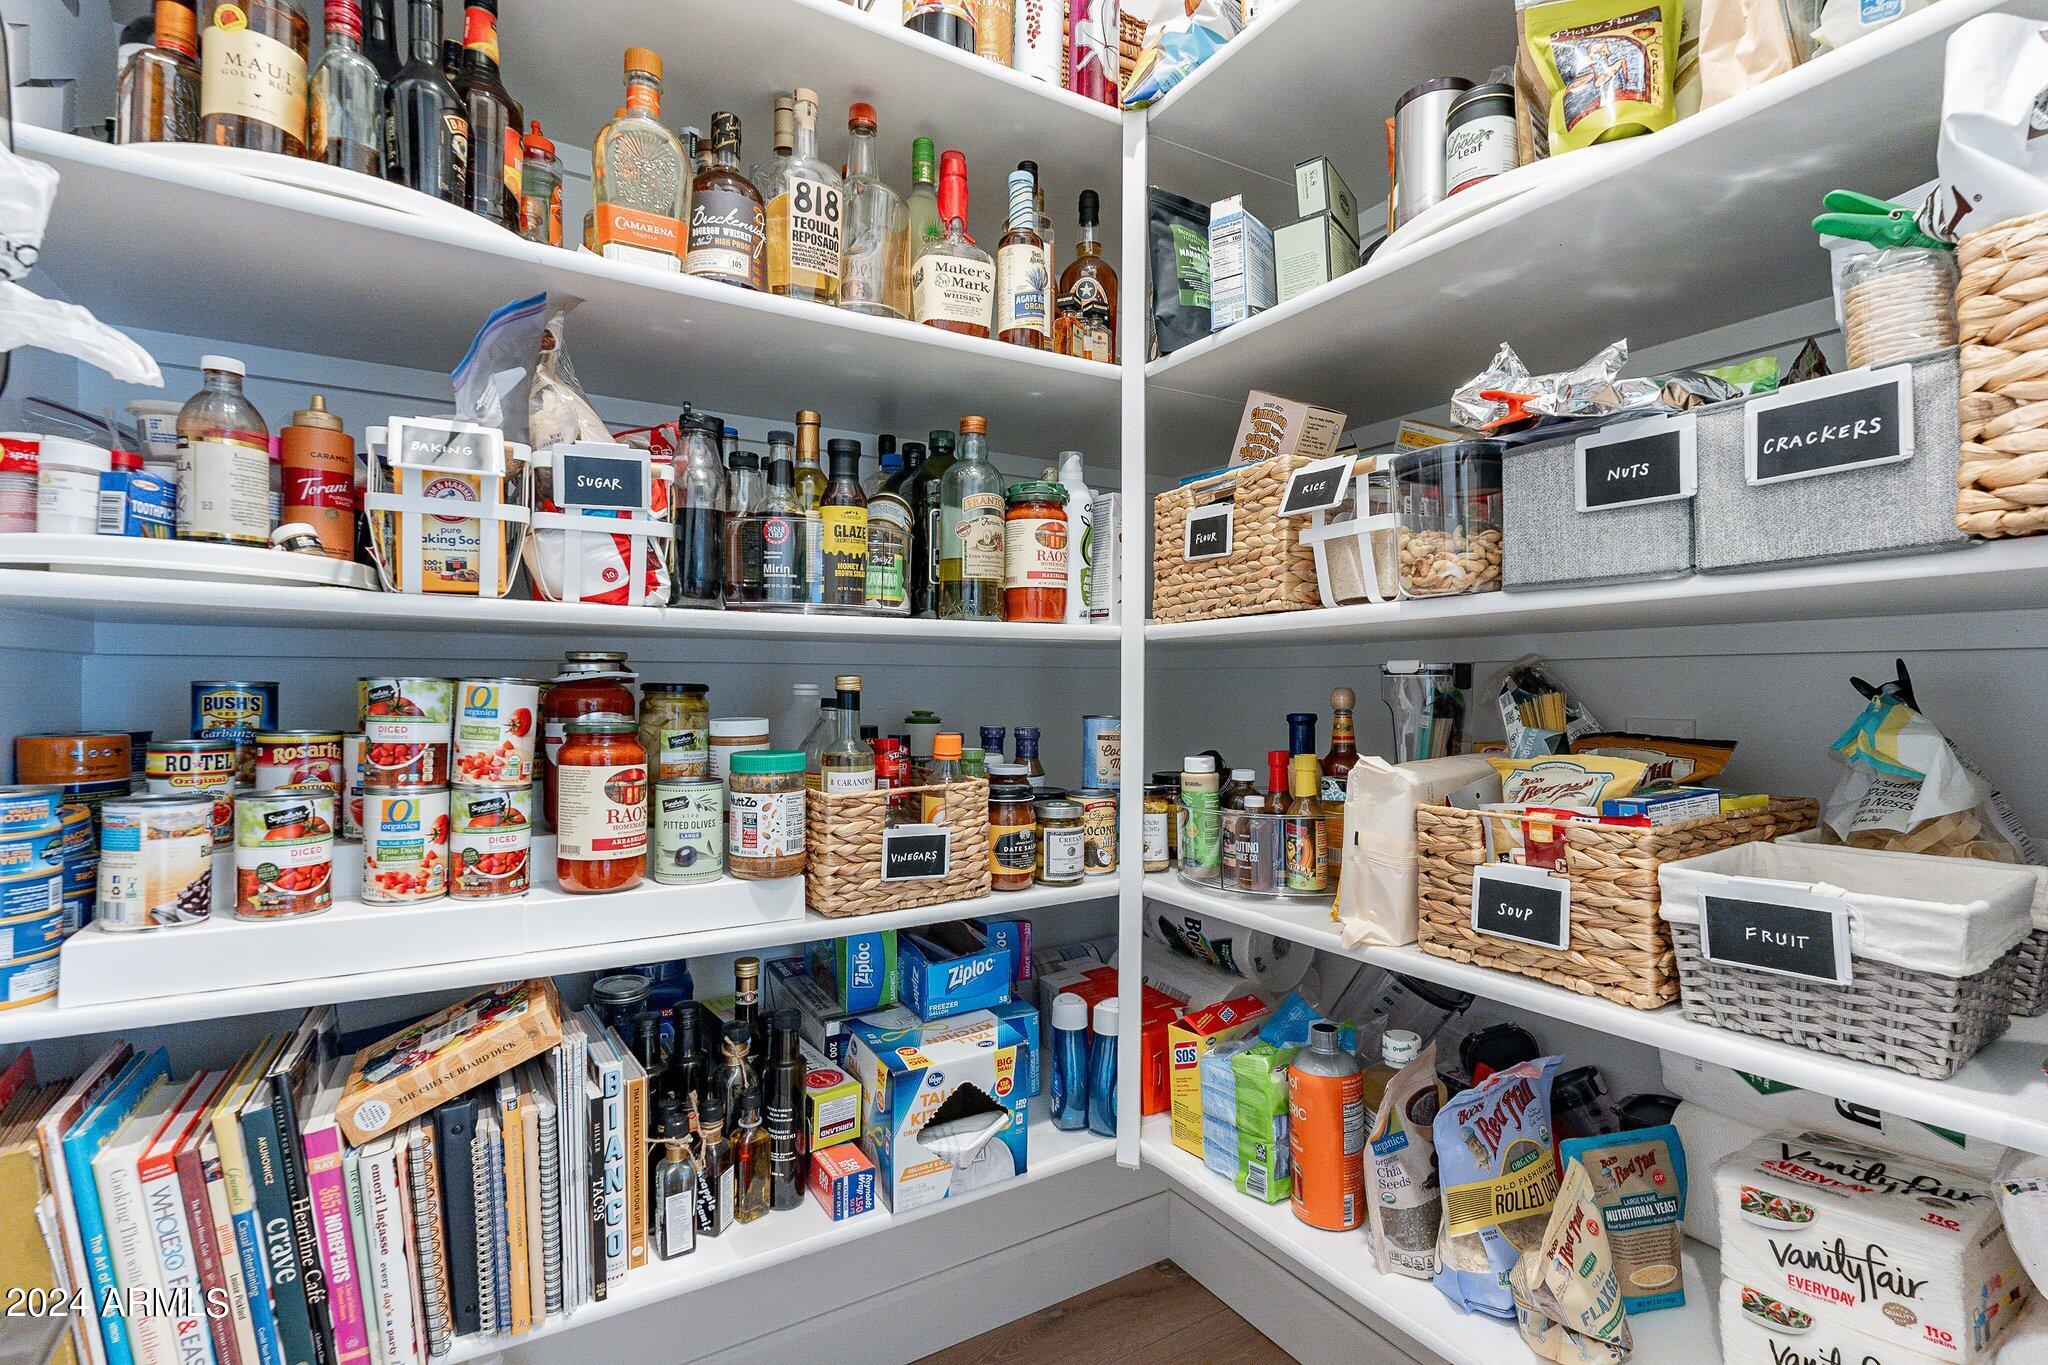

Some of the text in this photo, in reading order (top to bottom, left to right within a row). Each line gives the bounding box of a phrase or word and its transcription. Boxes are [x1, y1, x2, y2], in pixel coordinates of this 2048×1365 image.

[221, 68, 257, 80] GOLD
[1458, 141, 1483, 160] Leaf
[794, 181, 840, 222] 818
[614, 215, 675, 239] CAMARENA
[632, 231, 659, 241] TEQUILA
[691, 226, 752, 243] BOURBON WHISKEY
[692, 204, 767, 260] Breckenridge
[792, 215, 840, 240] TEQUILA
[714, 236, 731, 247] HIGH
[792, 229, 840, 254] REPOSADO
[731, 259, 742, 270] 105
[934, 261, 991, 280] Maker's
[951, 275, 991, 293] Mark
[943, 291, 982, 303] WHISKY
[1015, 294, 1038, 304] AGAVE
[1251, 406, 1288, 429] Cinnamon
[1253, 420, 1272, 433] Bun
[1763, 416, 1882, 455] CRACKERS
[310, 451, 350, 464] CARAMEL
[410, 441, 473, 456] BAKING
[1606, 462, 1649, 481] NUTS
[297, 477, 348, 500] Torani
[576, 475, 623, 490] SUGAR
[1302, 481, 1326, 494] RICE
[440, 527, 462, 536] pure
[833, 524, 868, 539] GLAZE
[1195, 531, 1217, 545] FLOUR
[423, 559, 443, 567] 100+
[763, 563, 791, 574] Mirin
[837, 562, 864, 571] HONEY &
[834, 570, 853, 578] BROWN
[203, 696, 262, 712] BUSH'S
[464, 708, 497, 718] organics
[378, 725, 408, 734] DICED
[174, 776, 226, 786] Original
[1871, 798, 1915, 811] Nests
[381, 822, 419, 832] organics
[663, 819, 716, 830] PITTED OLIVES
[488, 835, 517, 844] DICED
[1004, 845, 1023, 853] DATE
[290, 846, 322, 857] DICED
[400, 846, 423, 854] Diced
[891, 850, 937, 863] VINEGARS
[1250, 853, 1260, 863] CO.
[1497, 902, 1533, 922] SOUP
[1745, 926, 1810, 949] FRUIT
[853, 942, 874, 987] Ziploc
[947, 957, 995, 989] Ziploc
[912, 965, 920, 1010] Ziploc
[928, 1000, 959, 1012] FREEZER
[926, 1022, 993, 1045] KITCHEN
[956, 1031, 994, 1042] TALL
[829, 1041, 838, 1058] 200
[996, 1057, 1013, 1067] BIG
[398, 1040, 517, 1105] THE CHEESE BOARD DECK
[820, 1119, 854, 1138] KIRKLAND
[1474, 1077, 1537, 1162] Red Mill
[768, 1127, 791, 1135] ORGANIC
[1374, 1135, 1405, 1154] organics
[257, 1135, 275, 1187] AKUNOWICZ
[603, 1068, 626, 1257] BIANCO
[633, 1088, 641, 1226] THAT CHEESE PLATE WILL CHANGE YOUR LIFE
[1375, 1154, 1399, 1167] organic
[1511, 1150, 1538, 1171] ORGANIC
[1376, 1165, 1402, 1179] Chia
[1494, 1159, 1556, 1193] OLD FASHIONED
[1614, 1149, 1658, 1186] Red Mill
[1760, 1159, 1875, 1194] EVERYDAY
[863, 1174, 873, 1210] Reynolds
[1379, 1176, 1412, 1190] Seeds
[351, 1182, 362, 1217] creams
[854, 1173, 866, 1213] Wrap 150
[1495, 1181, 1543, 1216] ROLLED
[1623, 1197, 1639, 1206] LARGE
[1605, 1199, 1678, 1222] NUTRITIONAL YEAST
[1926, 1211, 1961, 1228] 110
[109, 1169, 143, 1284] Cooking Thin with
[1481, 1230, 1499, 1238] WHOLE
[216, 1224, 235, 1256] grilling
[150, 1185, 197, 1336] WHOLE30 &
[238, 1218, 259, 1298] Casual Entertaining
[266, 1218, 297, 1285] crave
[291, 1198, 326, 1305] Heartline Café
[326, 1229, 351, 1286] REPEATS
[371, 1164, 397, 1357] emeril lagasse every day's party
[1558, 1231, 1575, 1272] Red
[1768, 1237, 1866, 1303] Vanity
[229, 1273, 239, 1295] Louise
[1786, 1272, 1856, 1308] EVERYDAY
[1922, 1335, 1957, 1351] napkins
[1924, 1324, 1953, 1343] 110
